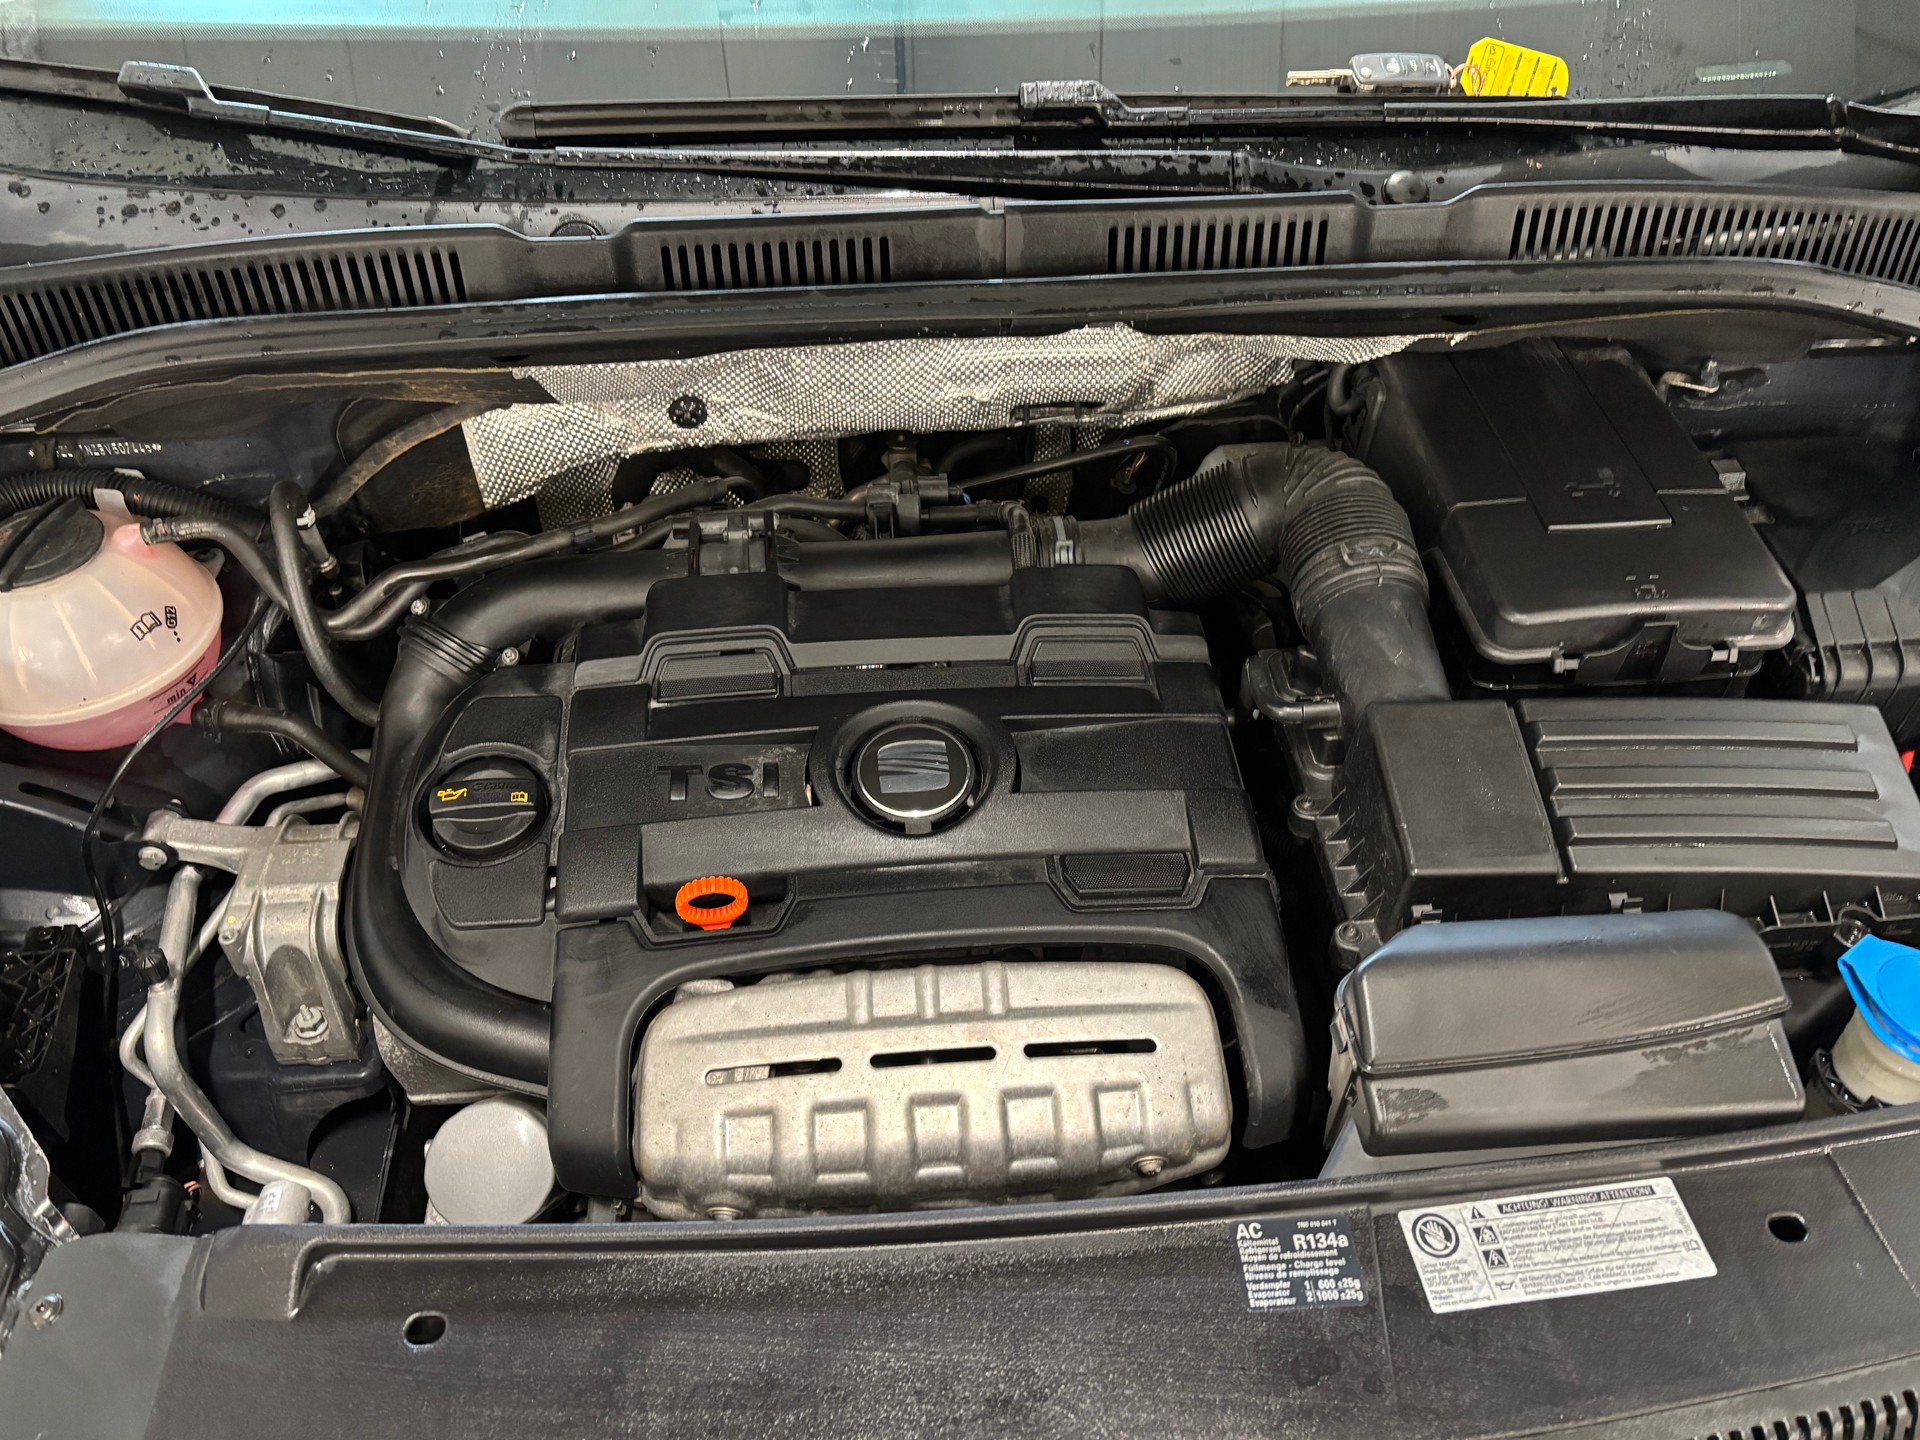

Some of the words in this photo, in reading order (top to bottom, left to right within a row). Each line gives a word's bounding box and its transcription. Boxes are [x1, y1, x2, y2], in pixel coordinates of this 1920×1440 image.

[165, 607, 177, 628] G12
[167, 688, 187, 704] min
[656, 762, 780, 801] TSI
[1502, 1200, 1549, 1213] ACHTUNG!
[1552, 1193, 1598, 1207] WARNING!
[1600, 1185, 1653, 1200] ATTENTION!
[1237, 1223, 1263, 1240] AC
[1237, 1237, 1279, 1248] Kältemittel
[1293, 1232, 1349, 1250] R134a
[1239, 1245, 1281, 1255] Refrigerant
[1241, 1253, 1267, 1263] Moyen
[1269, 1252, 1278, 1260] de
[1280, 1248, 1338, 1259] refroidissement
[1243, 1262, 1286, 1273] Füllmenge
[1294, 1260, 1324, 1269] Charge
[1325, 1257, 1346, 1266] level
[1245, 1271, 1274, 1281] Niveau
[1276, 1270, 1287, 1278] de
[1289, 1267, 1339, 1278] remplissage
[1246, 1281, 1290, 1291] Verdampfer
[1318, 1279, 1335, 1289] 600
[1248, 1289, 1290, 1299] Evaporator
[1306, 1290, 1313, 1302] 2
[1316, 1291, 1339, 1301] 1000
[1249, 1297, 1296, 1308] Evaporateur
